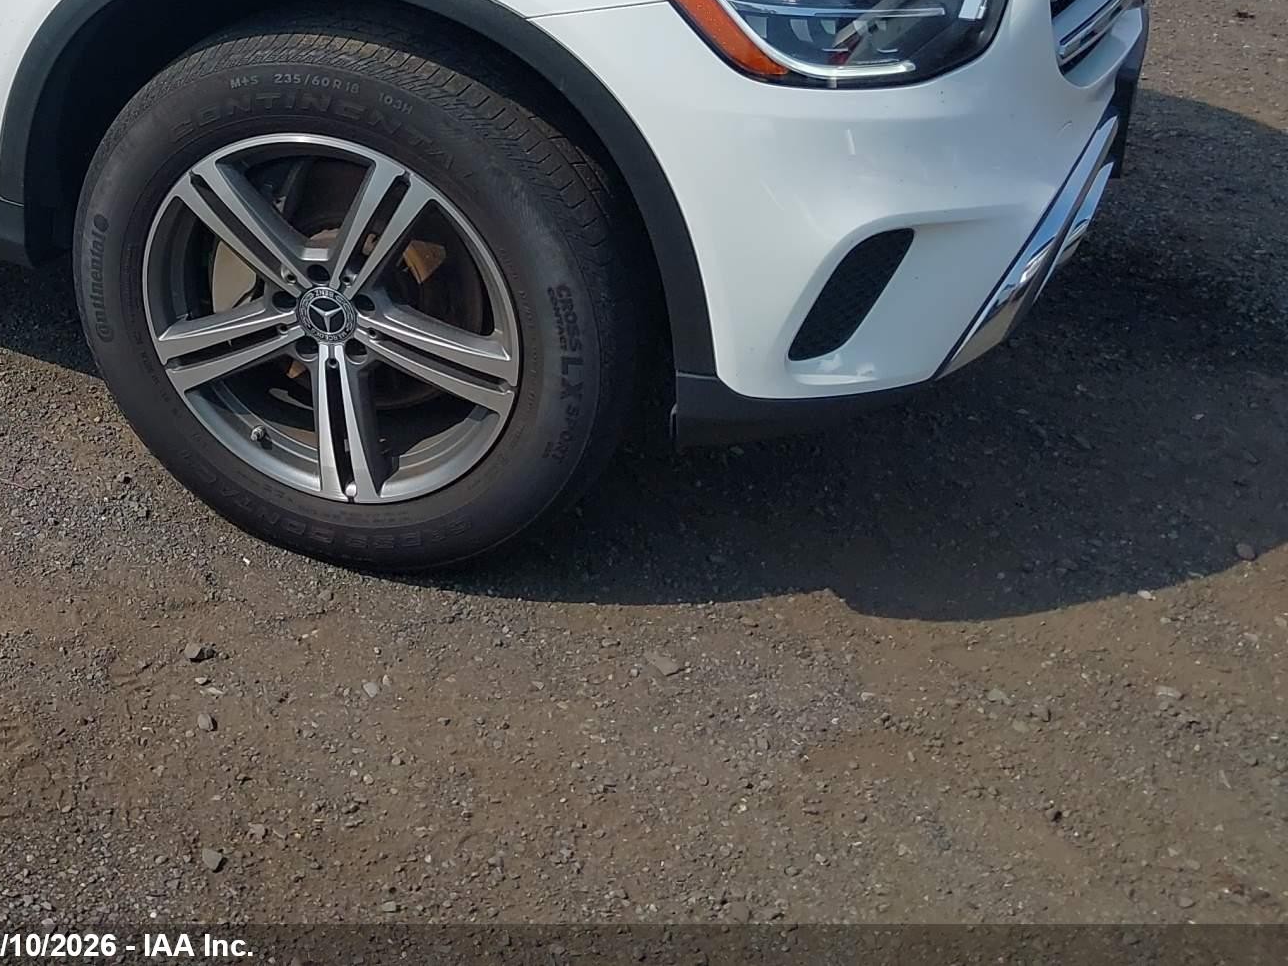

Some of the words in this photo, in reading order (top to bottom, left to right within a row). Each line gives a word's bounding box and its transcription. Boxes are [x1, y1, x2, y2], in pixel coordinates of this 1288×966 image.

[230, 74, 259, 90] M+S
[89, 230, 114, 343] Continental
[555, 284, 583, 353] CROSS
